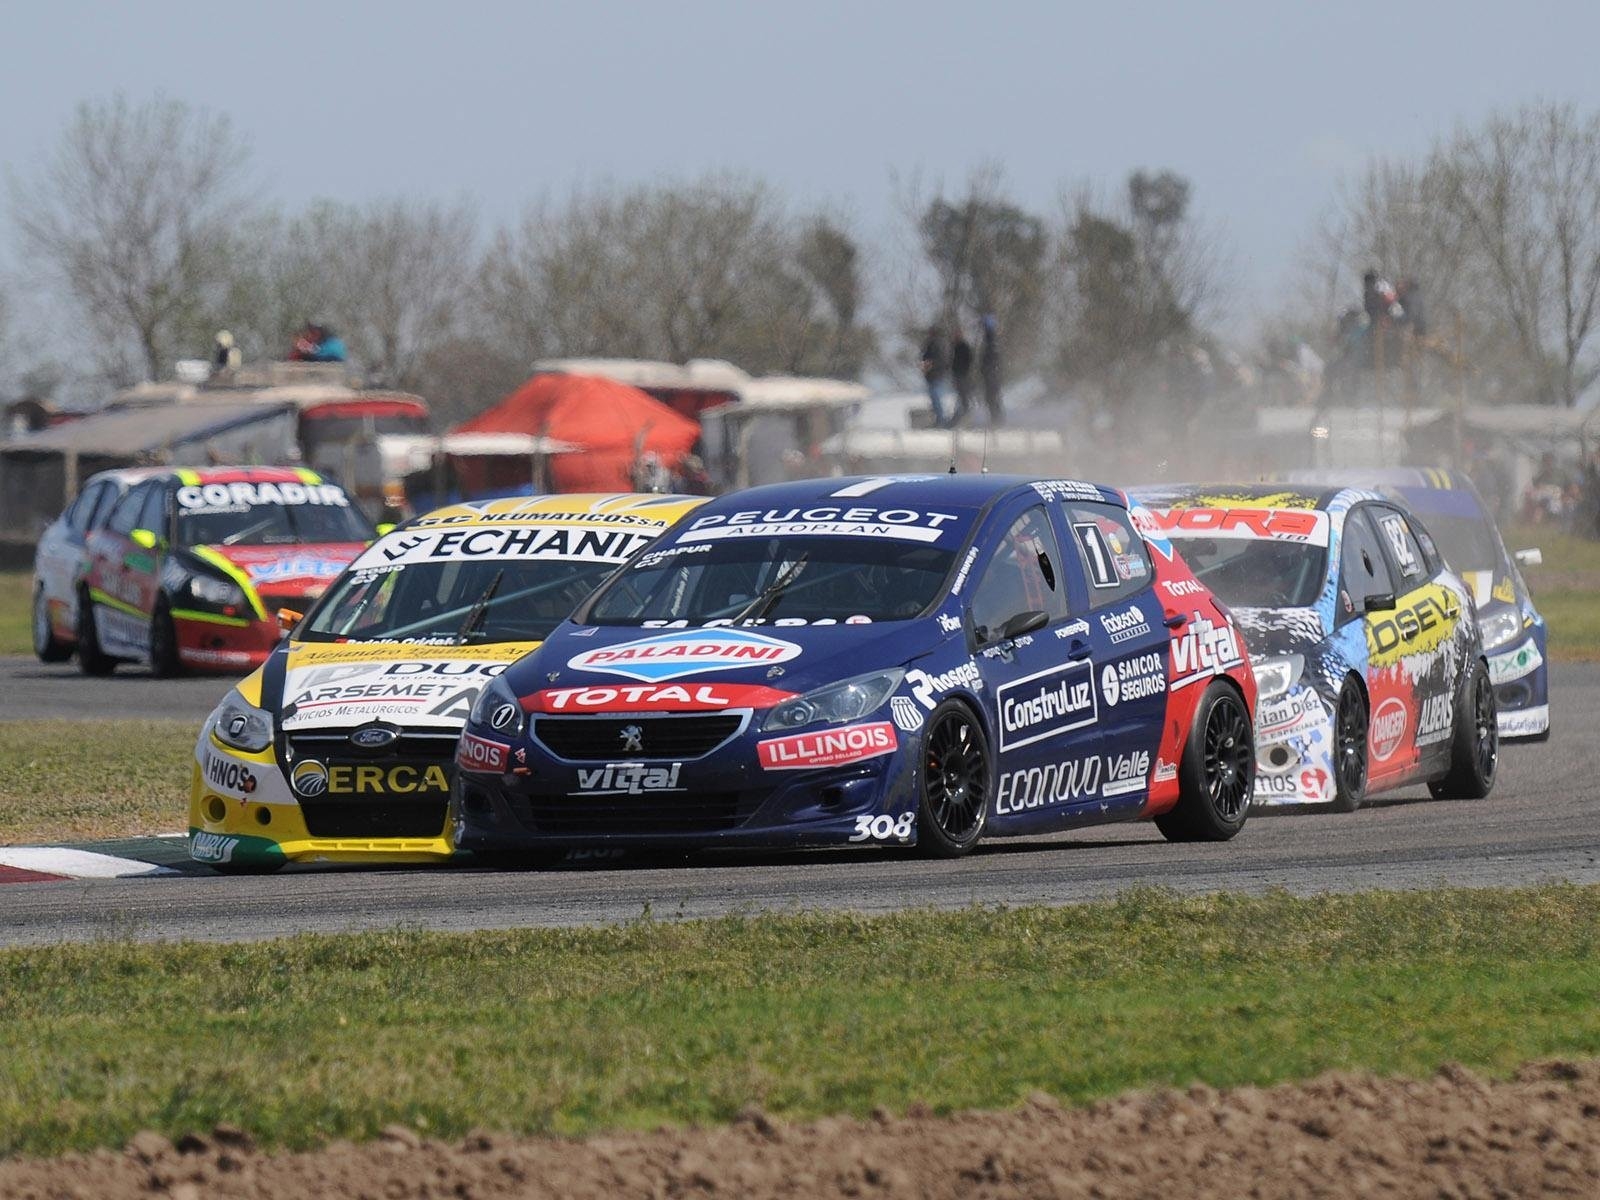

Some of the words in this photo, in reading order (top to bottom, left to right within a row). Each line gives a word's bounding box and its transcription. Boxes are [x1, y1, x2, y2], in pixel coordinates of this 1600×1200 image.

[176, 482, 350, 510] CORADIR
[480, 513, 635, 524] NEUMATICOS
[689, 508, 958, 531] PEUGEOT
[727, 523, 891, 536] AUTOPLAN
[642, 544, 713, 561] CHAPUR
[1085, 527, 1109, 583] 1
[1162, 580, 1205, 597] TOTAL
[583, 644, 786, 665] PALADINI
[1119, 652, 1163, 681] SANCOR
[293, 684, 457, 704] ARSEMET
[546, 686, 730, 709] TOTAL
[1122, 673, 1166, 702] SEGUROS
[494, 707, 512, 726] 1
[1004, 680, 1092, 732] ConstruLuz
[359, 729, 385, 743] Ford
[769, 727, 889, 763] ILLINOIS
[1107, 750, 1150, 781] Vallé
[848, 811, 916, 842] 308
